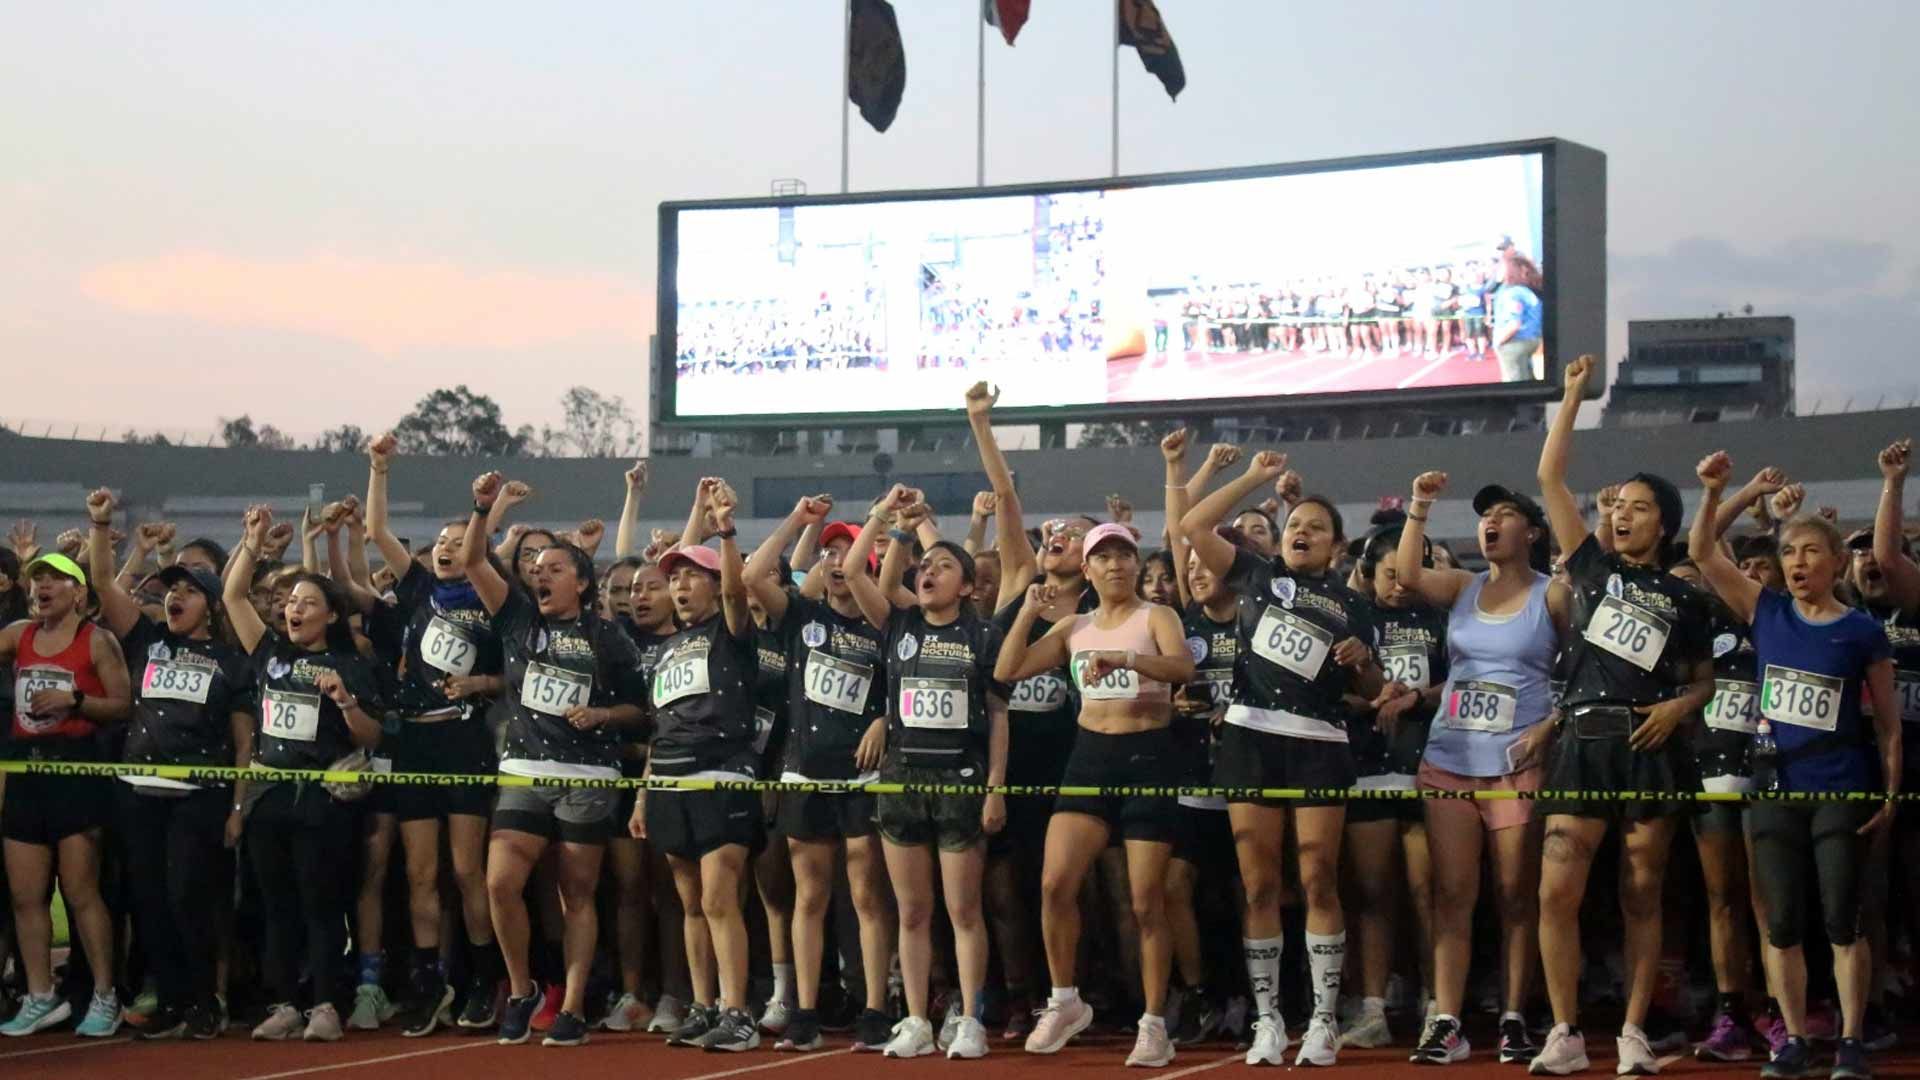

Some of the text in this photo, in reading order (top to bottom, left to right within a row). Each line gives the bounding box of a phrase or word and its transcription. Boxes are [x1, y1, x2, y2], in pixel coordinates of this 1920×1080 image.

[922, 642, 970, 653] CARRERA
[1268, 623, 1313, 662] 659
[1603, 612, 1651, 653] 206
[431, 632, 469, 668] 612
[920, 648, 976, 660] NOCTURNA
[150, 667, 203, 693] 3833
[532, 675, 581, 707] 1574
[663, 661, 694, 693] 405
[811, 665, 862, 703] 1614
[1011, 677, 1061, 703] 562
[913, 690, 953, 719] 636
[1459, 691, 1500, 721] 858
[1769, 679, 1831, 719] 3186
[273, 703, 297, 730] 26
